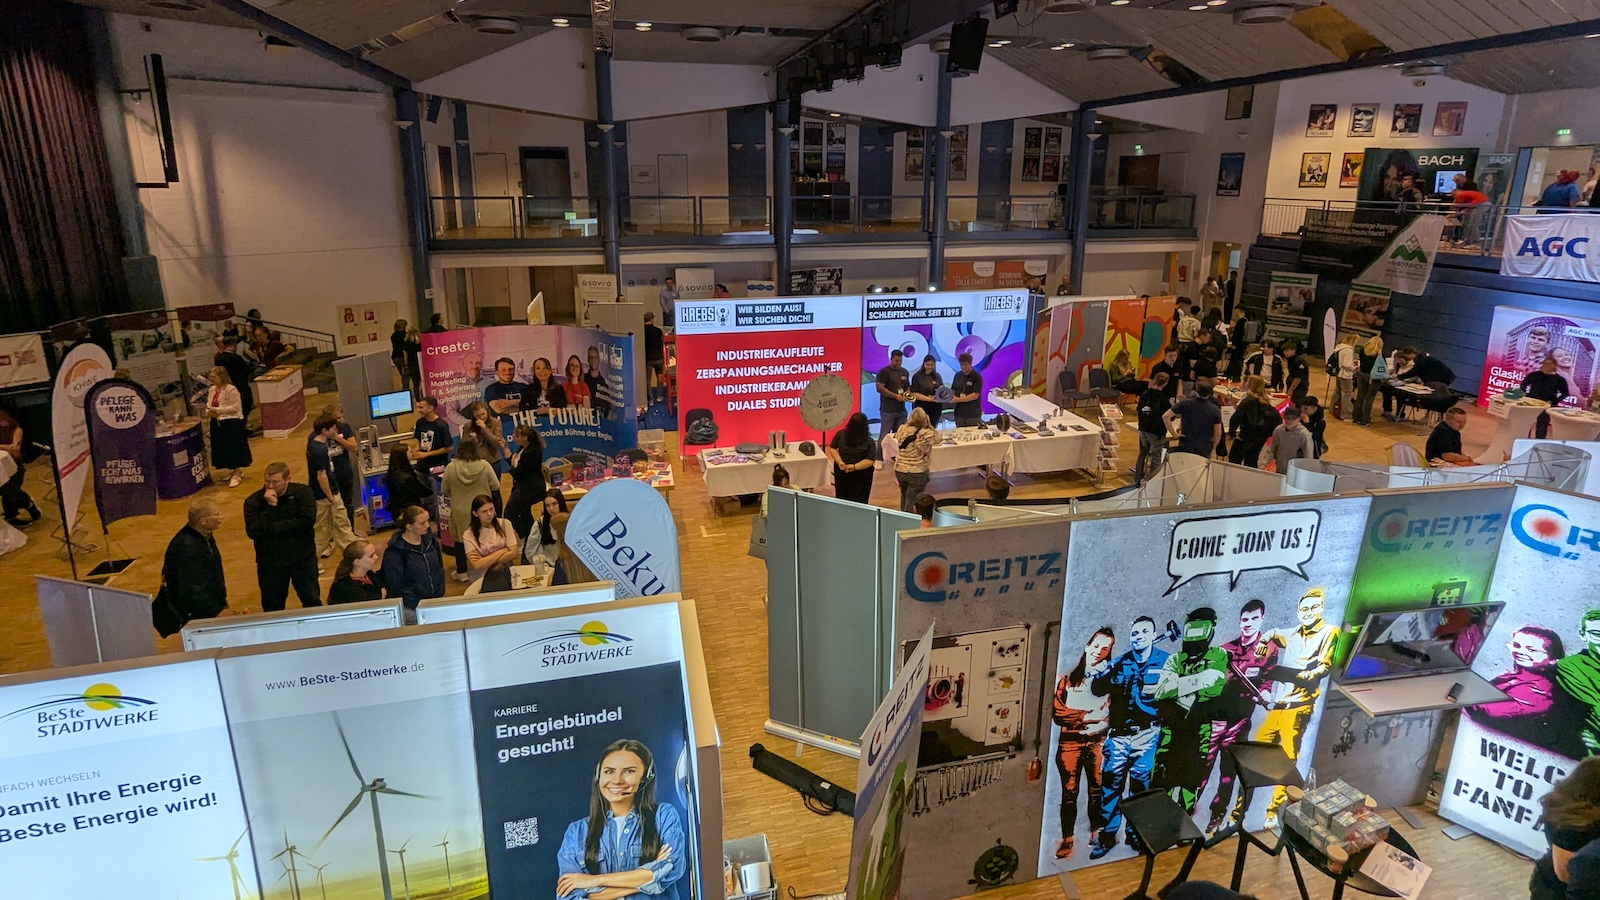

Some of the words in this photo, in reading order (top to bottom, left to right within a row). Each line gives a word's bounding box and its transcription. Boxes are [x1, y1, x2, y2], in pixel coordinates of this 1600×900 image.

[1418, 155, 1464, 166] BACH
[1516, 236, 1590, 260] AGC
[738, 304, 754, 315] WIR
[755, 304, 782, 314] BILDEN
[784, 303, 802, 313] AUS!
[869, 299, 915, 309] INNOVATIVE
[985, 295, 1012, 310] KREBS
[681, 306, 715, 322] KREBS
[738, 315, 754, 325] WIR
[755, 315, 787, 325] SUCHEN
[788, 314, 811, 323] DICH!
[869, 309, 927, 319] SCHLEIFTECHNIK
[928, 308, 943, 318] SEIT
[944, 307, 960, 317] 1895
[426, 341, 476, 356] create:
[716, 346, 825, 362] INDUSTRIEKAUFLEUTE
[429, 370, 454, 380] Design
[696, 362, 843, 380] ZERSPANUNGSMECHANIKER
[73, 375, 98, 392] KHWE
[430, 377, 467, 388] Marketing
[715, 381, 811, 395] INDUSTRIEKERAMI
[1488, 375, 1520, 389] Karrie
[438, 388, 444, 396] &
[445, 384, 476, 394] Software
[100, 396, 136, 407] PFLEGE
[436, 391, 482, 405] igitalisierung
[727, 399, 767, 412] DUALES
[769, 397, 802, 409] STUDI
[109, 405, 133, 414] KANN
[115, 412, 137, 423] WAS
[509, 409, 542, 428] THE
[548, 407, 601, 429] FUTURE!
[540, 429, 563, 437] oolste
[564, 428, 585, 437] Bühne
[586, 430, 597, 438] der
[101, 467, 121, 477] ECHT
[122, 466, 142, 476] WAS
[106, 459, 136, 469] PFLEGE:
[105, 474, 144, 484] BEWIRKEN
[1405, 513, 1503, 538] REITZ
[1175, 534, 1227, 560] COME
[1232, 529, 1276, 555] JOIN
[1280, 526, 1303, 550] US
[589, 512, 666, 597] Beku
[575, 538, 634, 599] KUNSTSTOFFWE
[949, 552, 1062, 585] REITZ
[948, 578, 1060, 600] GROUP
[542, 642, 580, 656] BeSte
[540, 645, 634, 669] STADTWERKE
[265, 661, 425, 692] www.BeSte-Stadtwerke.de
[37, 706, 85, 724] BeSte
[493, 703, 538, 718] KARRIERE
[37, 708, 159, 738] STADTWERKE
[495, 705, 623, 740] Energiebündel
[497, 735, 575, 764] gesucht!
[1480, 737, 1566, 784] WELC
[37, 770, 101, 788] WECHSELN
[1492, 768, 1533, 801] TO
[66, 790, 112, 807] Ihre
[117, 772, 203, 799] Energie
[0, 822, 67, 844] BeSte
[73, 804, 159, 830] Energie
[165, 791, 218, 815] wird!
